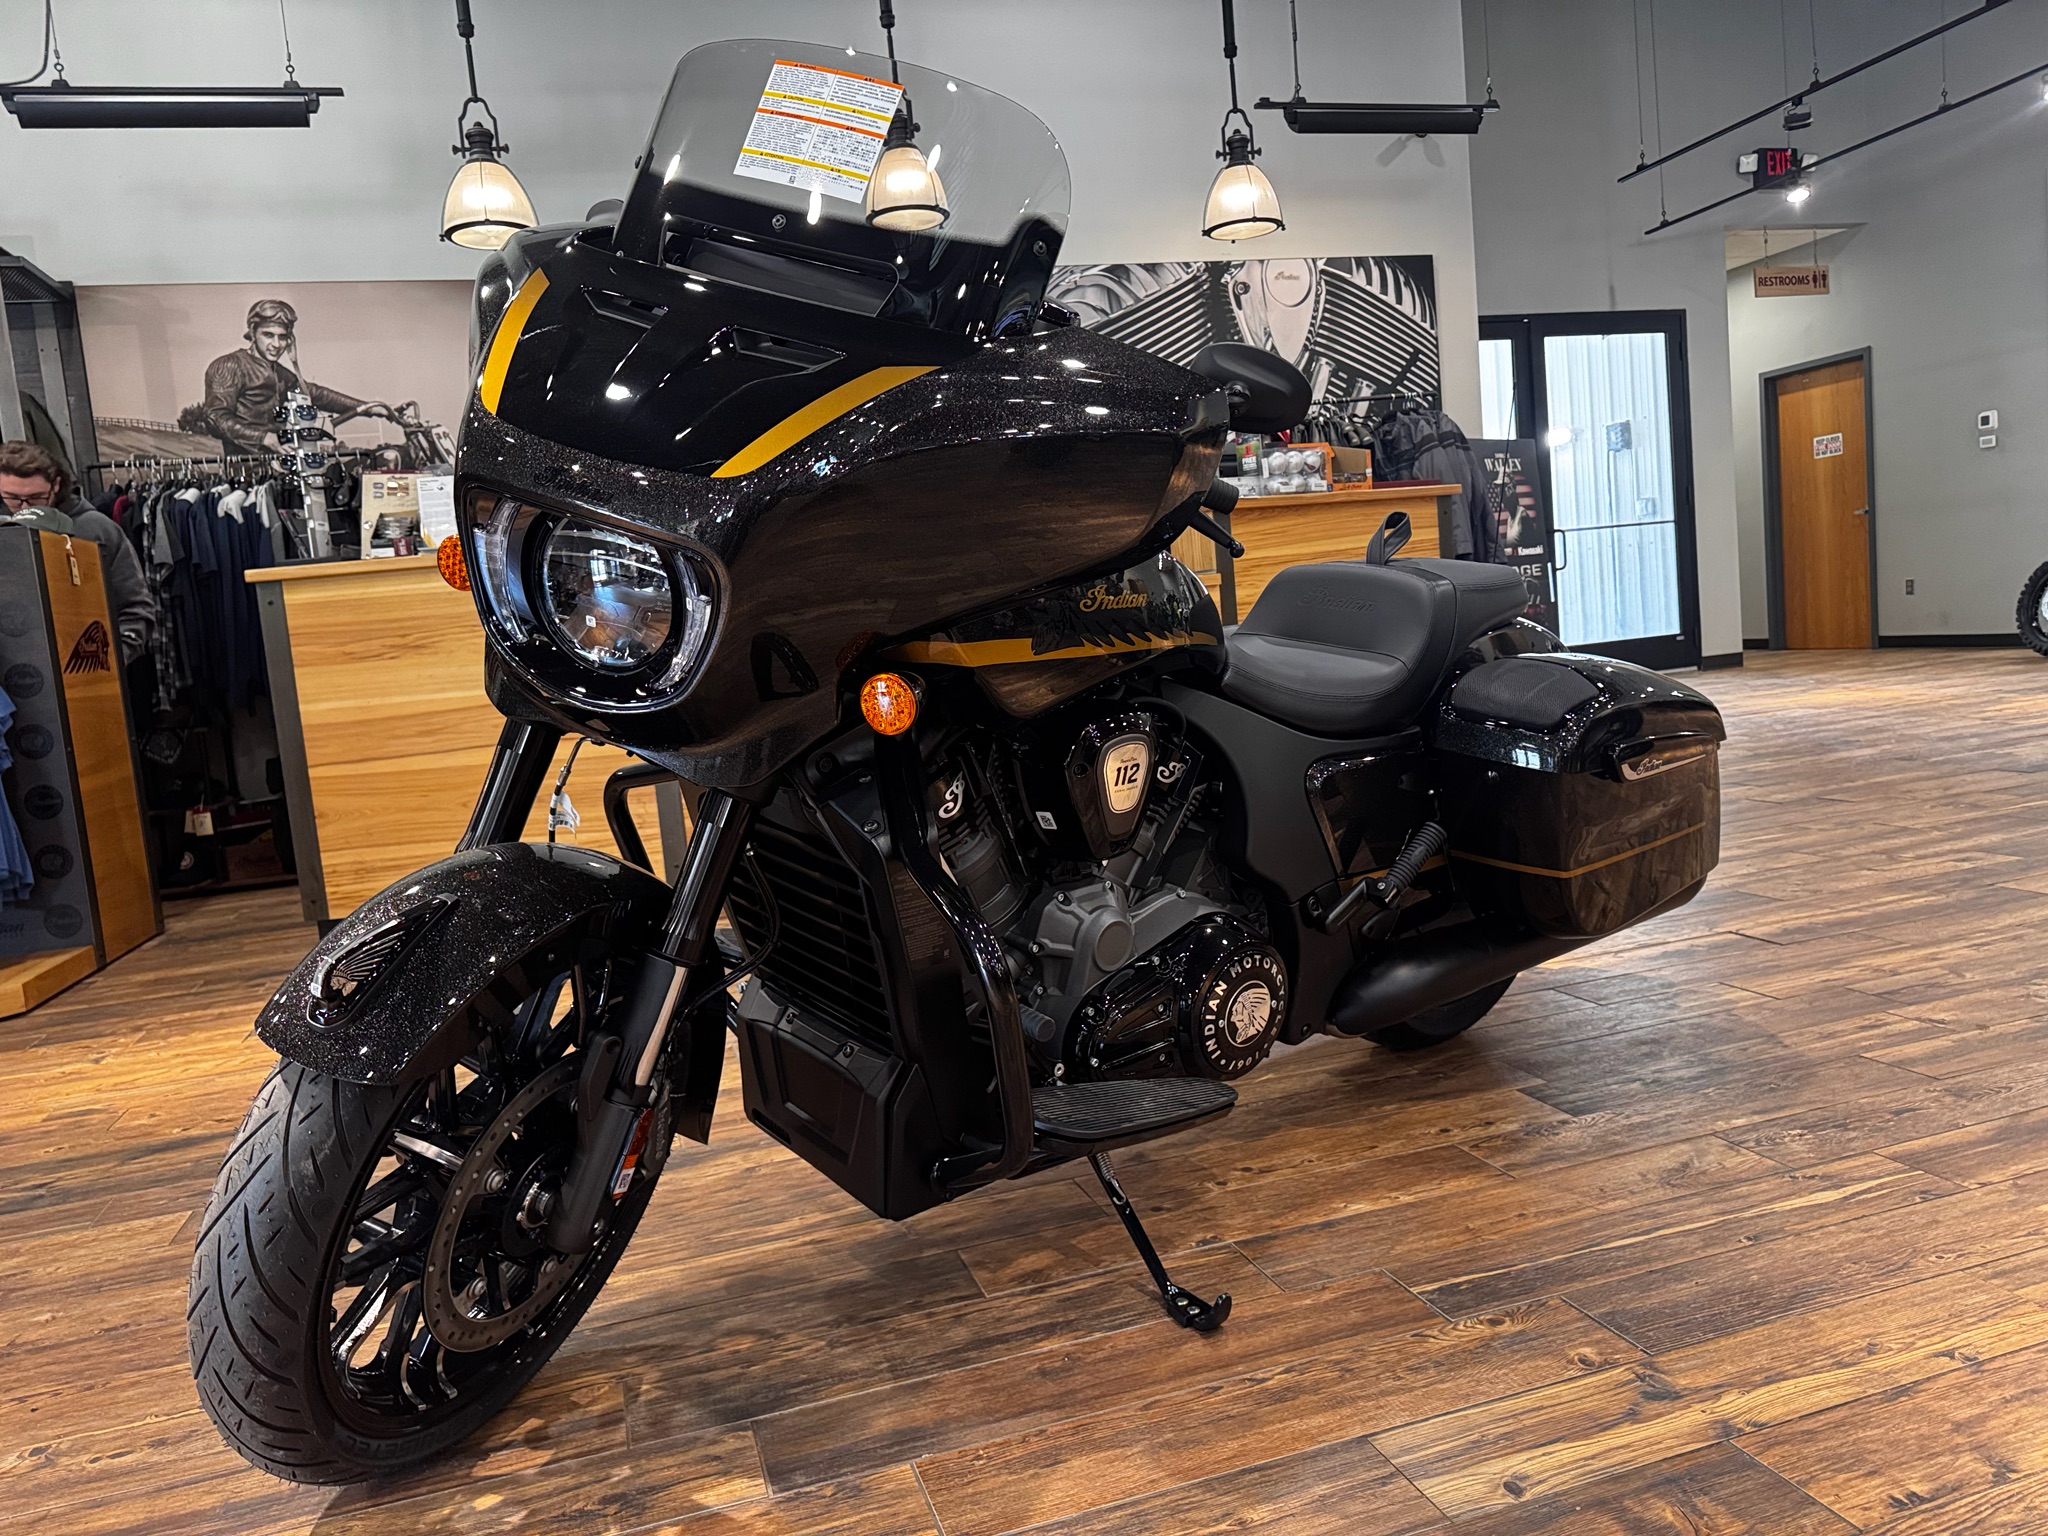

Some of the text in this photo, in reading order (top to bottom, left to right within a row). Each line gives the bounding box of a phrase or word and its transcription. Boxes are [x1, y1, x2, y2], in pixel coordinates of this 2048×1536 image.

[1758, 274, 1811, 288] RESTROOMS
[1080, 584, 1149, 612] Indian
[1114, 763, 1140, 787] 112
[1204, 980, 1228, 1060] INDIAN
